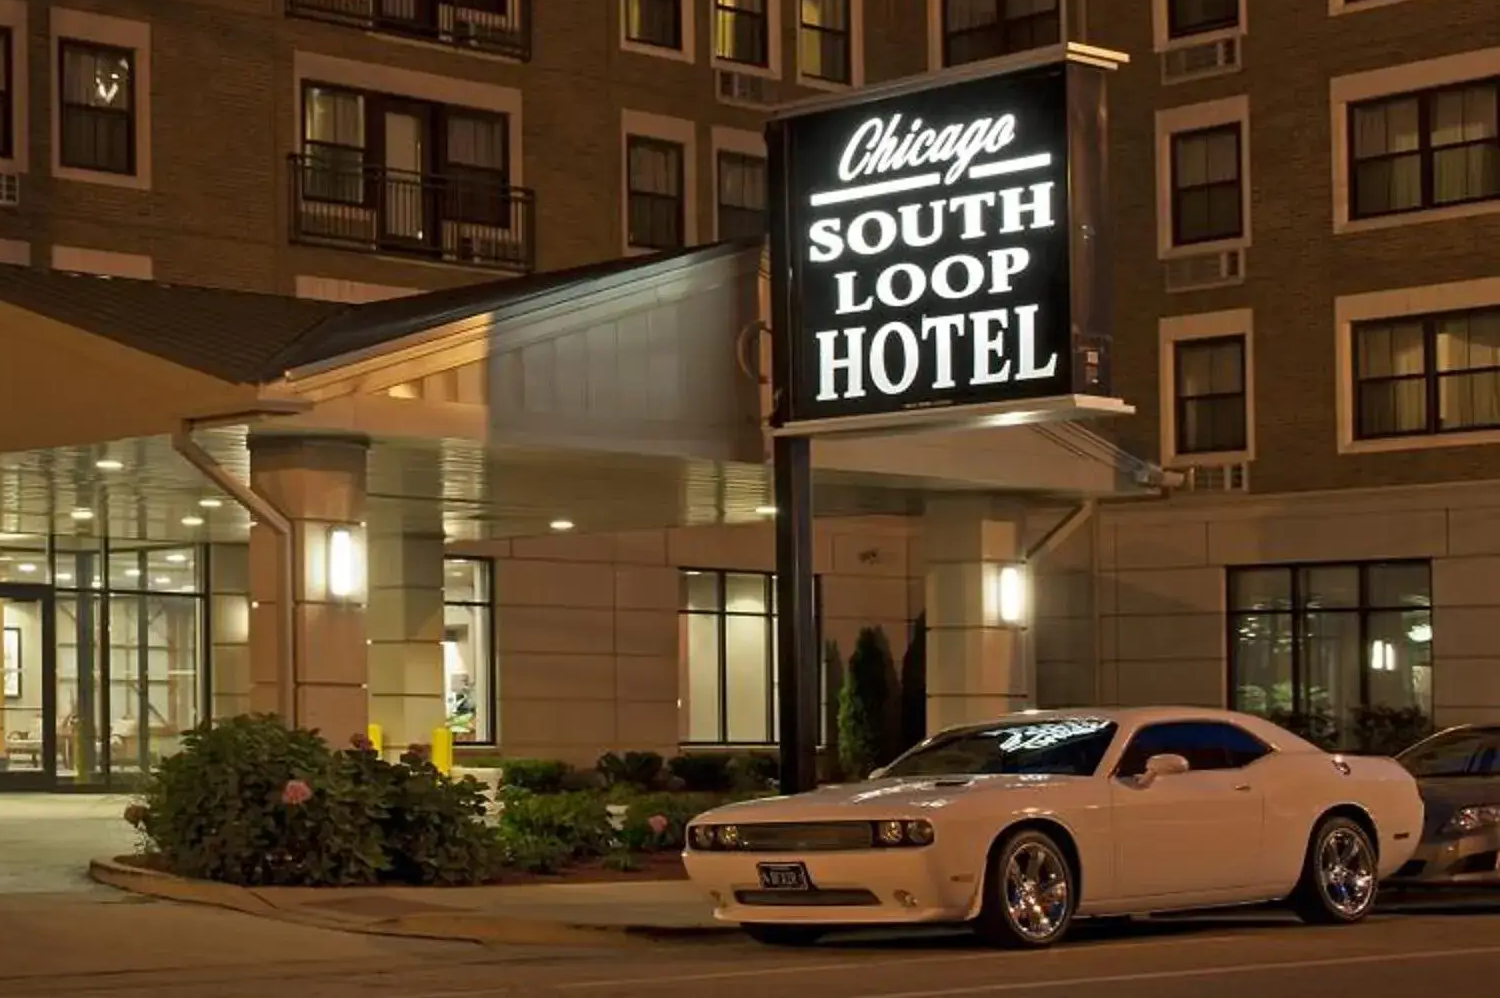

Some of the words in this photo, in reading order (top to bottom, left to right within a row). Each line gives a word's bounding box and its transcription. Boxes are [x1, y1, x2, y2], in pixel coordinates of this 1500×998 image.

[838, 113, 1016, 185] Chicago
[809, 181, 1055, 262] SOUTH
[834, 247, 1030, 314] LOOP
[816, 304, 1057, 401] HOTEL
